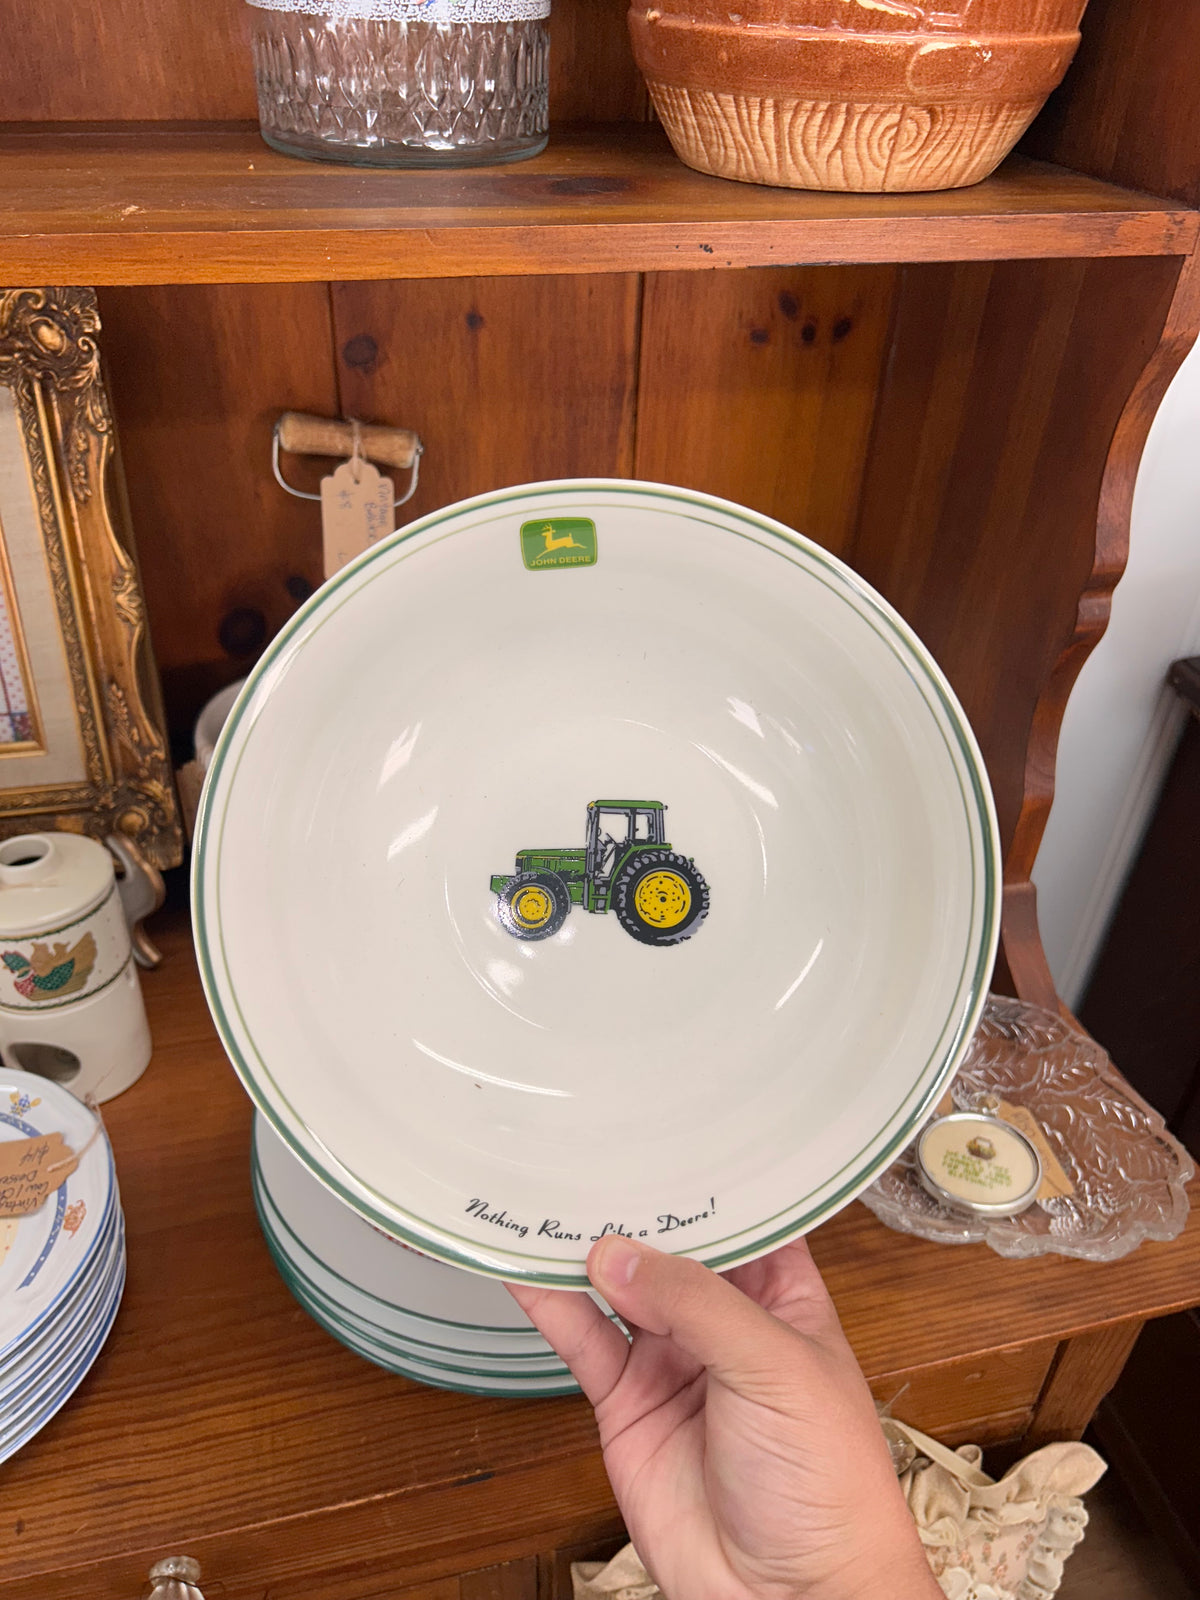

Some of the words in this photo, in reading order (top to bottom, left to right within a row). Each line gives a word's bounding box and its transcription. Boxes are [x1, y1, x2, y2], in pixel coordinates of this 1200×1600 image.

[530, 557, 557, 567] JOHN
[558, 555, 591, 564] DEERE
[464, 1198, 529, 1238] Nothing
[537, 1219, 582, 1241] Runs
[590, 1222, 633, 1242] Lke
[639, 1229, 649, 1238] a
[656, 1196, 716, 1234] Deere!
